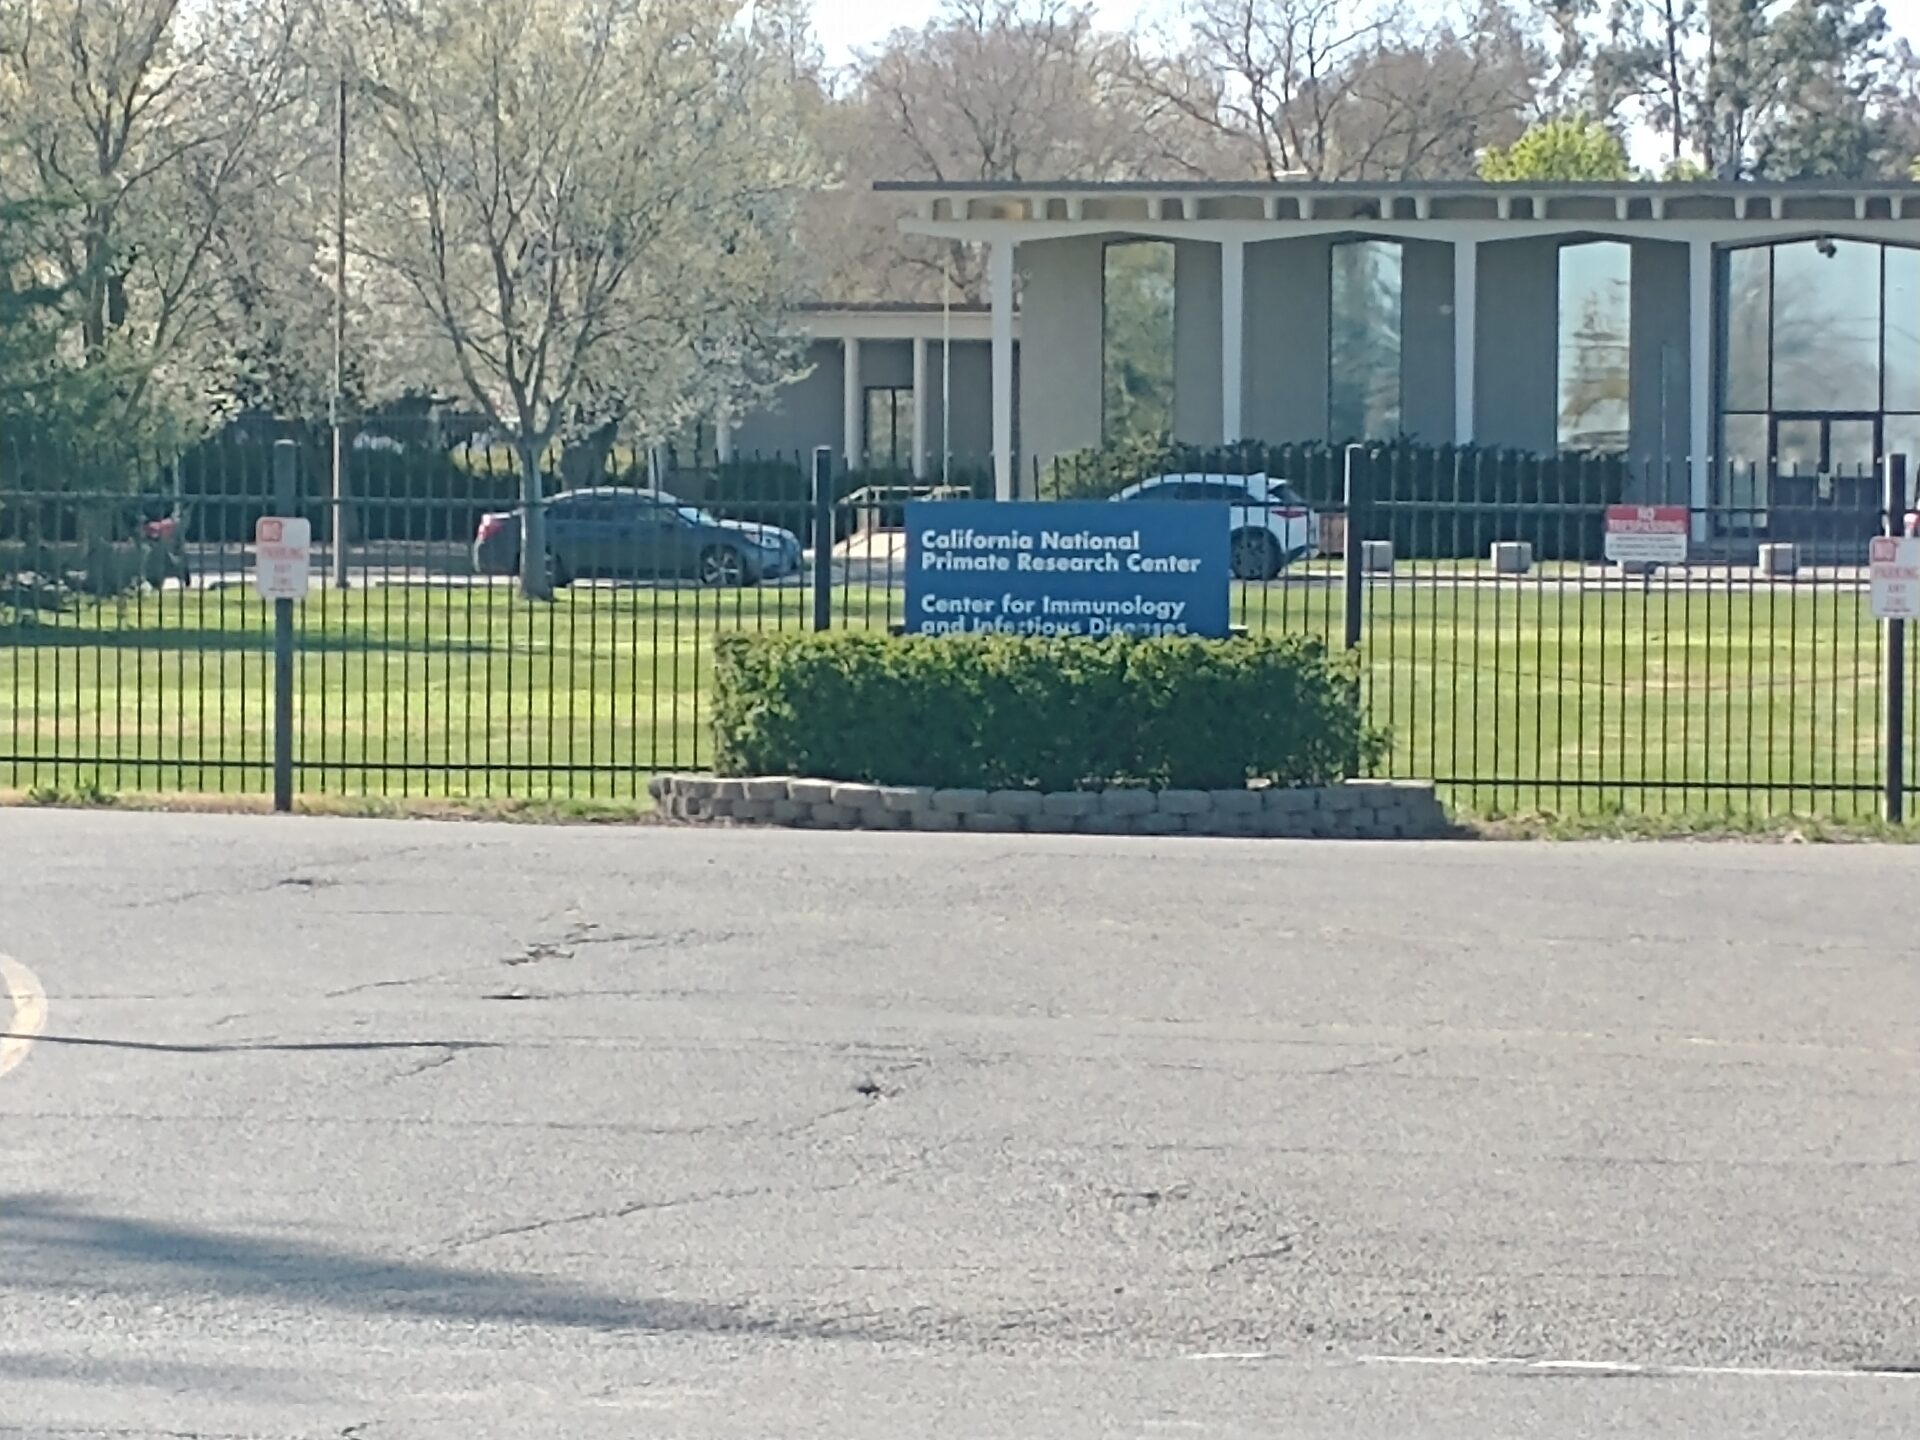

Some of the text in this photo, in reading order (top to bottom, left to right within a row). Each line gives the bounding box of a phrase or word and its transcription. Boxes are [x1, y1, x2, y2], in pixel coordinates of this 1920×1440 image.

[921, 529, 1140, 551] California National
[921, 551, 1202, 573] Primate Research Center
[921, 592, 1186, 620] Center for Immunology
[921, 614, 965, 634] and
